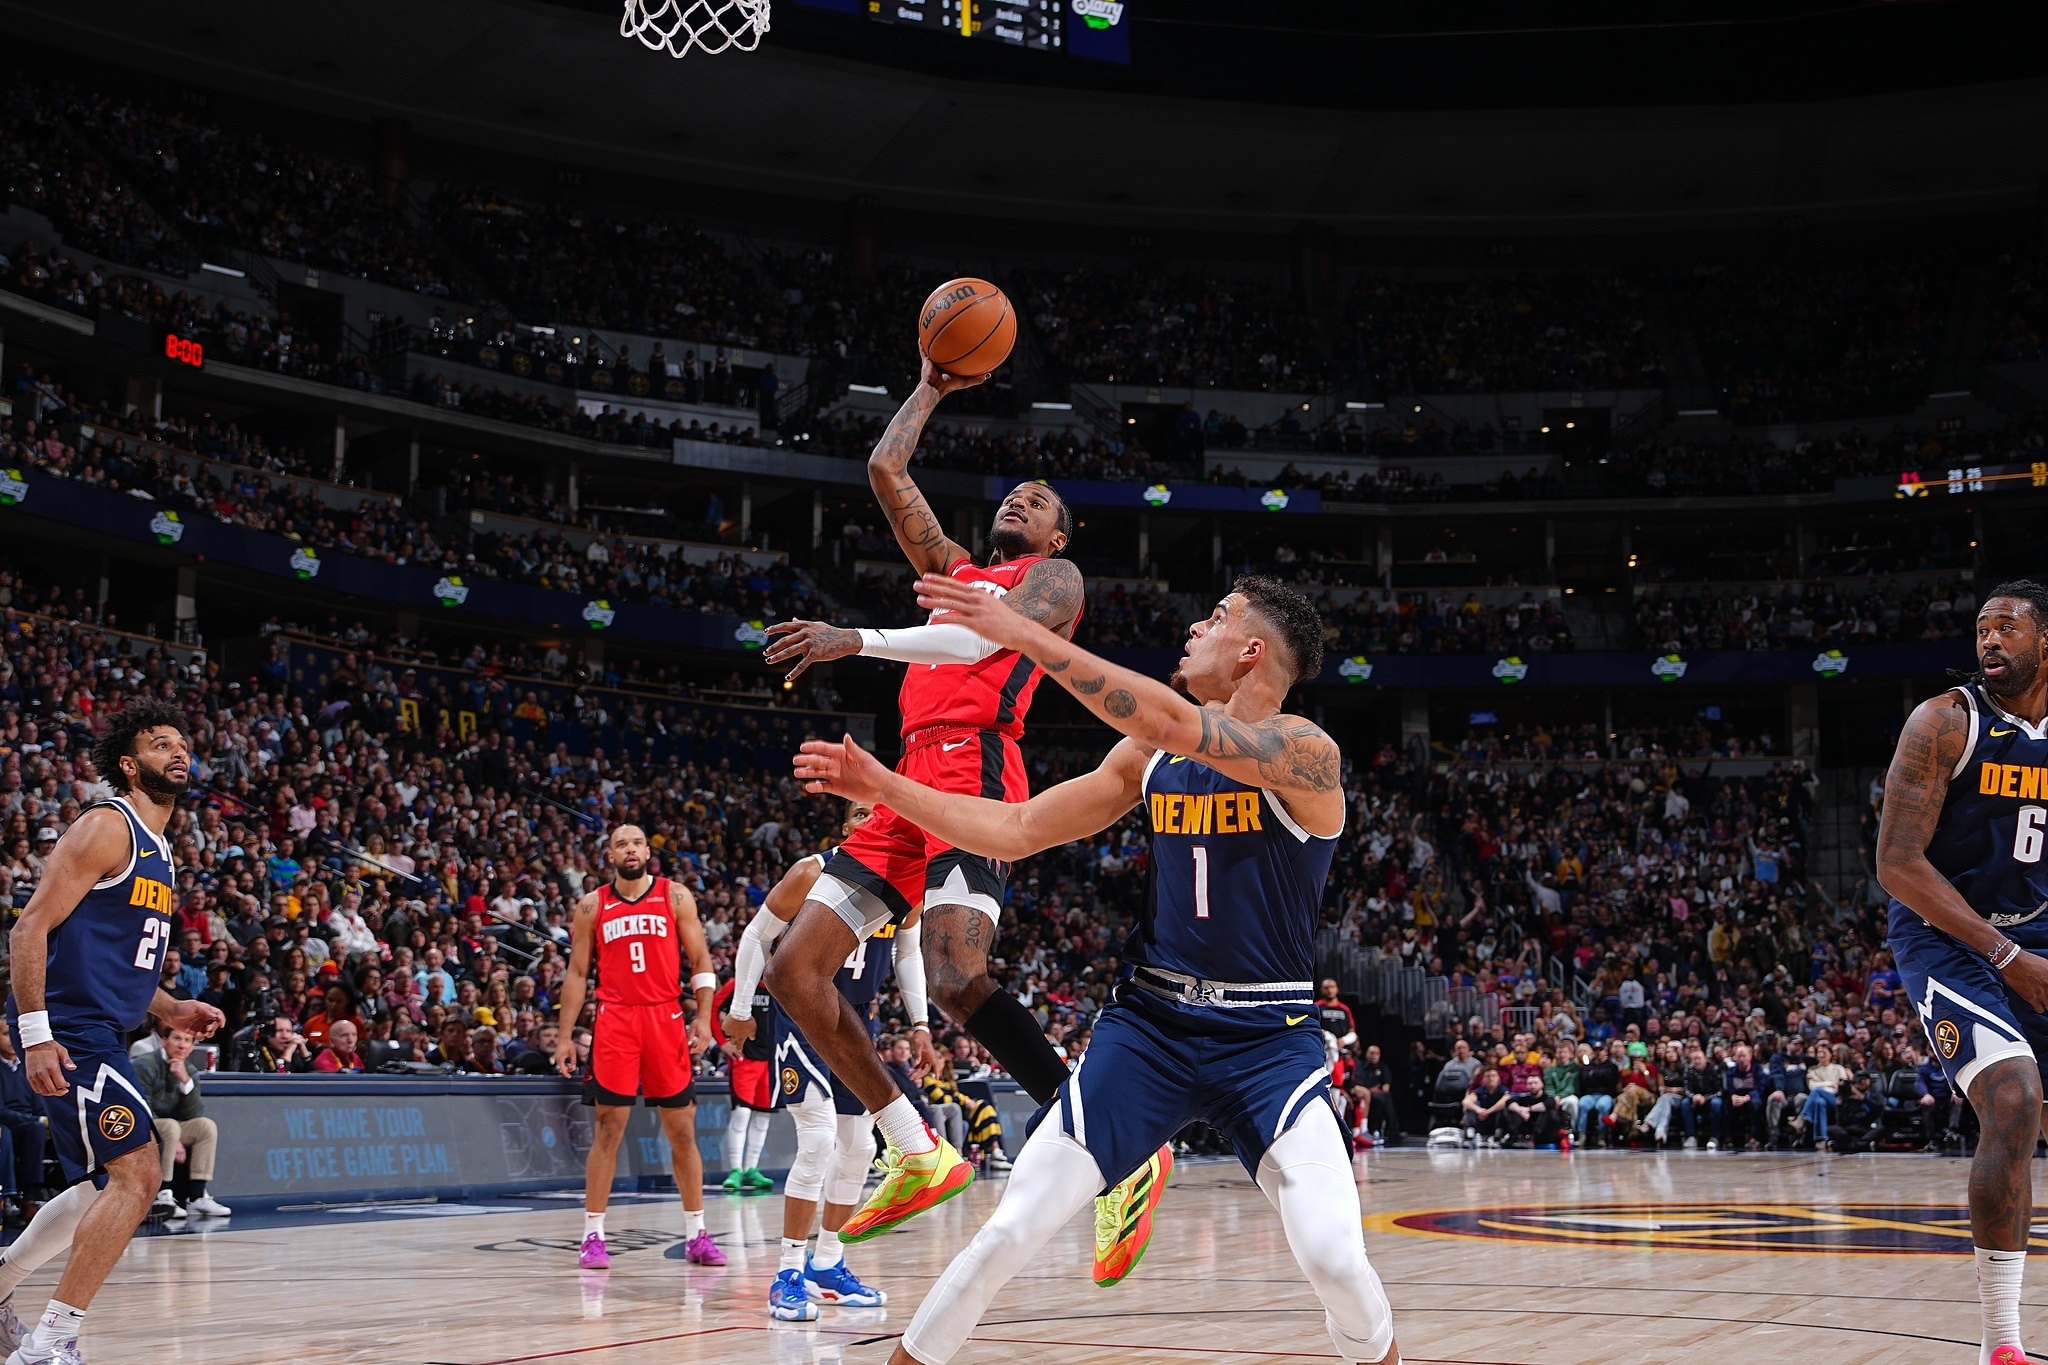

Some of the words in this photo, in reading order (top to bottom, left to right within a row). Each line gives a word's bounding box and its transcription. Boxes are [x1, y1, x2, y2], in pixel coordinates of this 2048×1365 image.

[897, 6, 923, 21] Green
[922, 285, 978, 330] Wilson
[165, 334, 202, 367] 8:00
[1150, 792, 1264, 834] DENVER
[2013, 805, 2047, 863] 6
[1192, 846, 1209, 919] 1
[134, 917, 171, 973] 27
[602, 914, 667, 944] ROCKETS
[629, 941, 646, 973] 9
[843, 942, 867, 980] 4
[284, 1108, 318, 1139] WE
[321, 1107, 371, 1138] HAVE
[372, 1107, 426, 1137] YOUR
[266, 1147, 341, 1180] OFFICE
[343, 1144, 398, 1176] GAME
[399, 1143, 455, 1175] PLAN.
